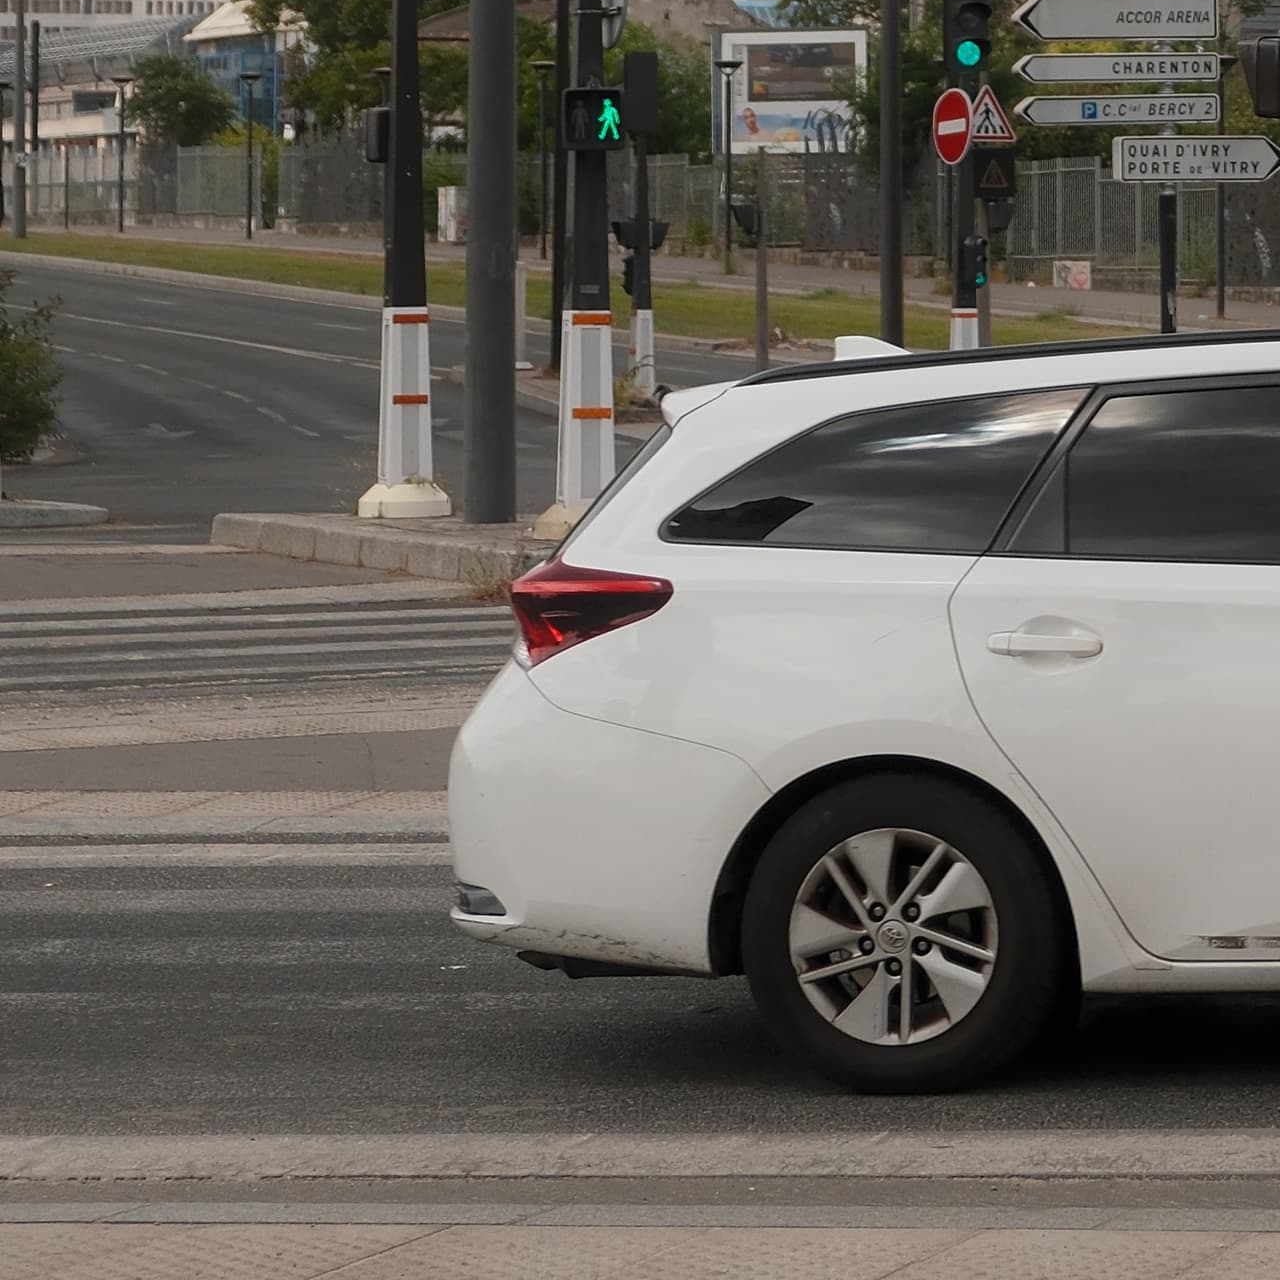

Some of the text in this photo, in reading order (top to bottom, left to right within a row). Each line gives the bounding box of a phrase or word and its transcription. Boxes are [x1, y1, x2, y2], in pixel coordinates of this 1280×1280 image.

[1116, 10, 1210, 24] ACCOR ARENA
[1112, 60, 1212, 75] CHARENTON
[1148, 103, 1196, 116] BERCY
[1204, 102, 1212, 115] 2
[1128, 144, 1168, 158] QUAI
[1128, 161, 1181, 175] PORTE
[1212, 161, 1260, 174] VITRY
